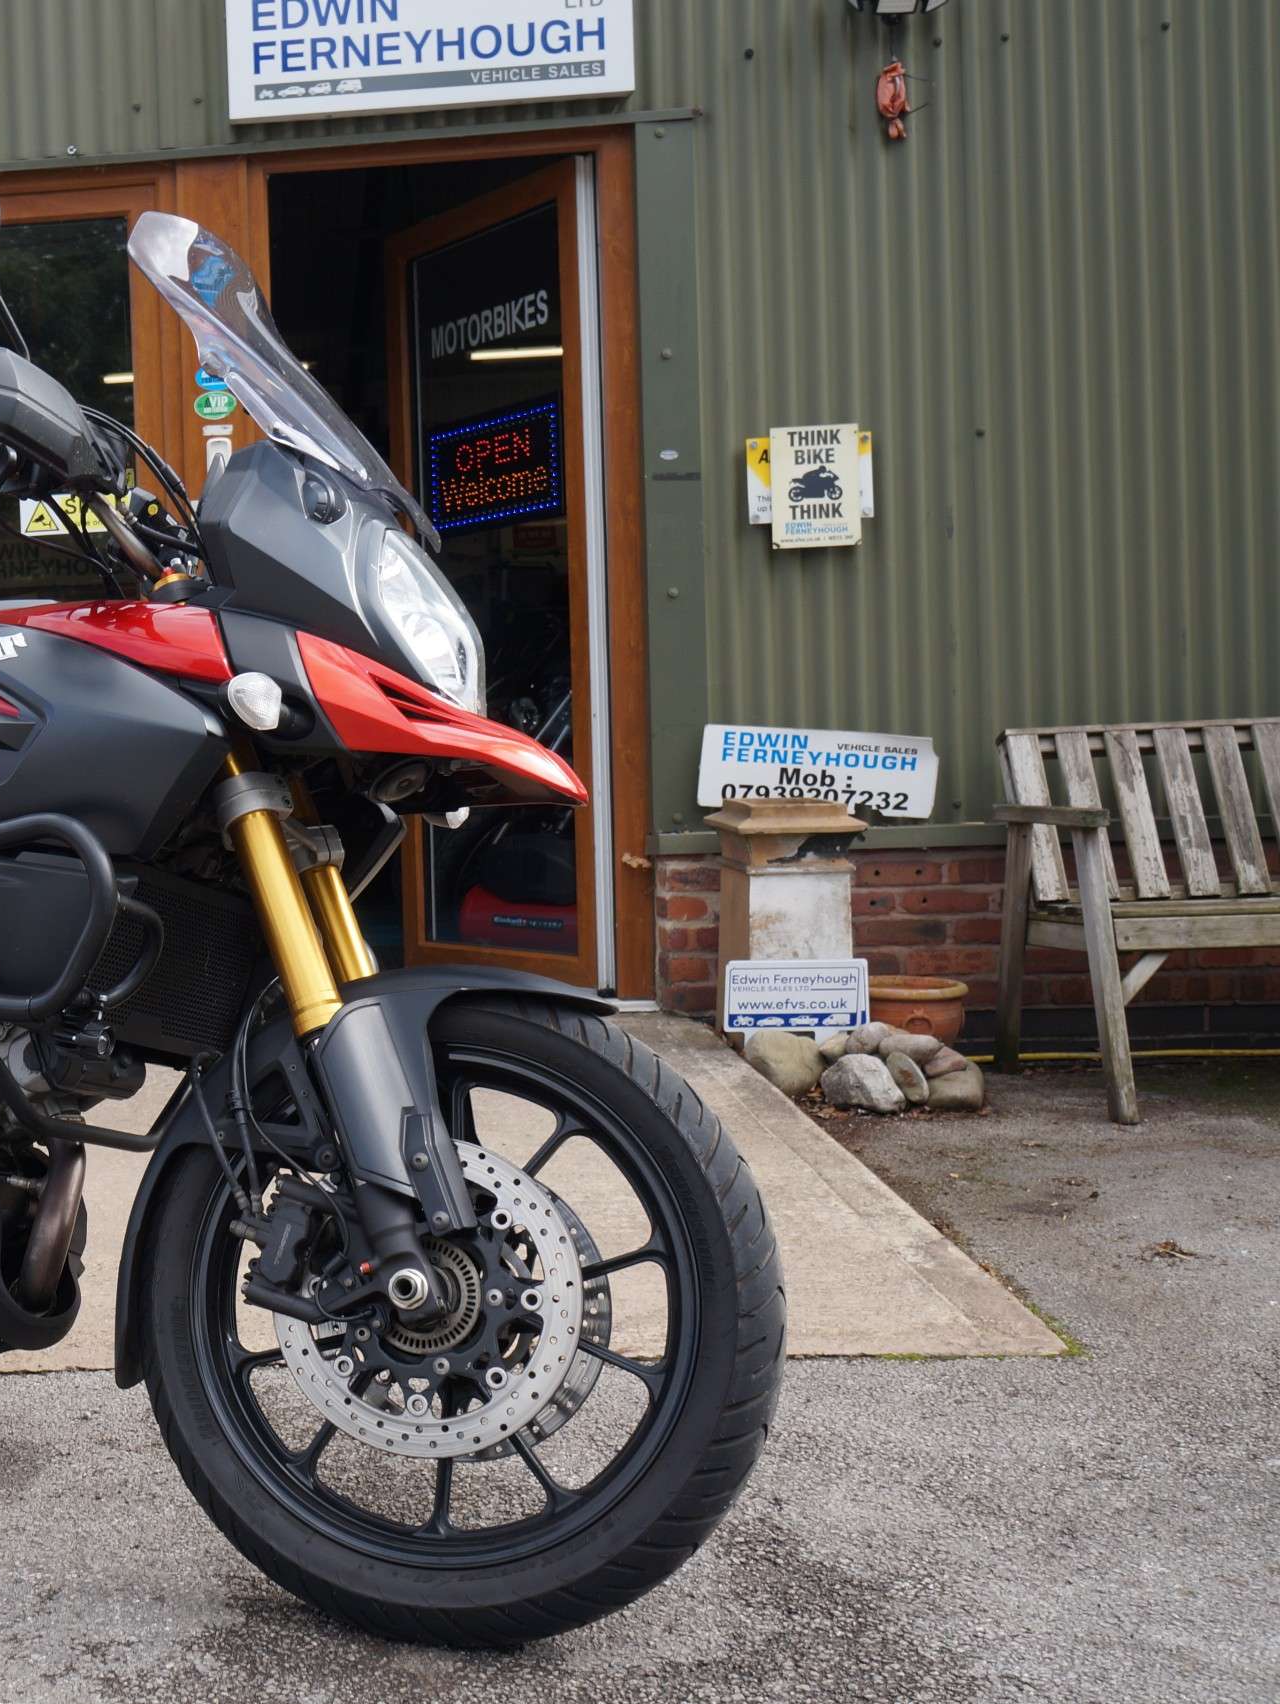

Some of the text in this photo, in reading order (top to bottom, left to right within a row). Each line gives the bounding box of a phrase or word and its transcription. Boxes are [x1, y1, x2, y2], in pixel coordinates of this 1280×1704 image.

[252, 0, 398, 31] EDWIN
[253, 17, 606, 75] FERNEYHOUGH
[470, 62, 603, 84] VEHICLE SALES
[431, 289, 549, 359] MOTORBIKES
[787, 429, 841, 447] THINK
[455, 428, 531, 472] OPEN
[794, 448, 835, 465] BIKE
[440, 465, 548, 513] Welcome
[789, 503, 843, 520] THINK
[723, 731, 809, 750] EDWIN
[837, 743, 918, 755] VEHICLE SALES
[722, 748, 917, 771] FERNEYHOUGH
[779, 767, 835, 788] Mob
[732, 973, 857, 988] Edwin Ferneyhough
[738, 998, 848, 1010] www.efvs.co.uk
